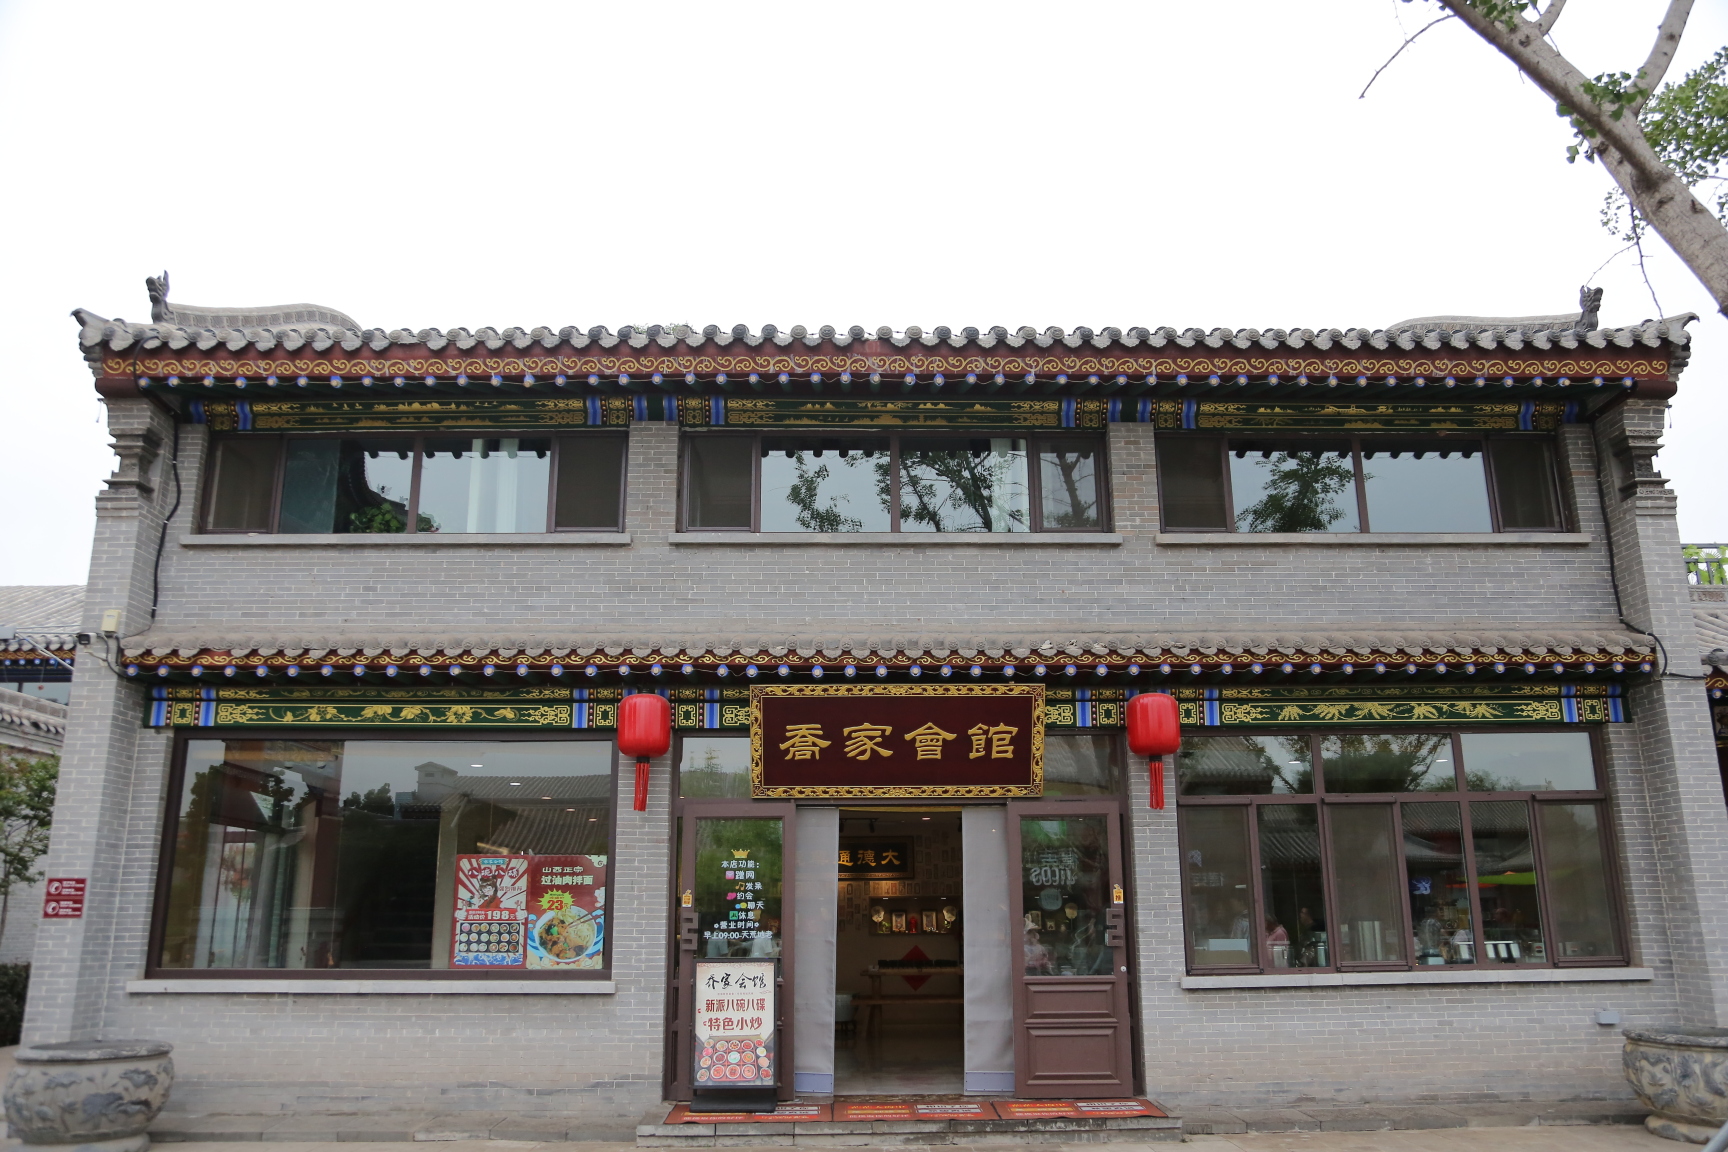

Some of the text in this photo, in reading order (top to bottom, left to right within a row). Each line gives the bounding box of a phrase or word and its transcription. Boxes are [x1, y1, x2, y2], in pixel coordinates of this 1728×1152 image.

[779, 722, 1019, 761] 喬家會館
[542, 865, 584, 873] 山西正宗
[735, 870, 755, 880] 蹭网
[540, 875, 594, 886] 过油肉拌面
[745, 882, 763, 890] 发呆
[736, 891, 754, 900] 约会
[747, 901, 765, 910] 聊天
[738, 911, 755, 920] 休息
[720, 921, 754, 929] 营业时间
[705, 971, 767, 990] 乔家会馆
[705, 997, 766, 1013] 新派八碗八碟
[707, 1016, 763, 1032] 特色小炒
